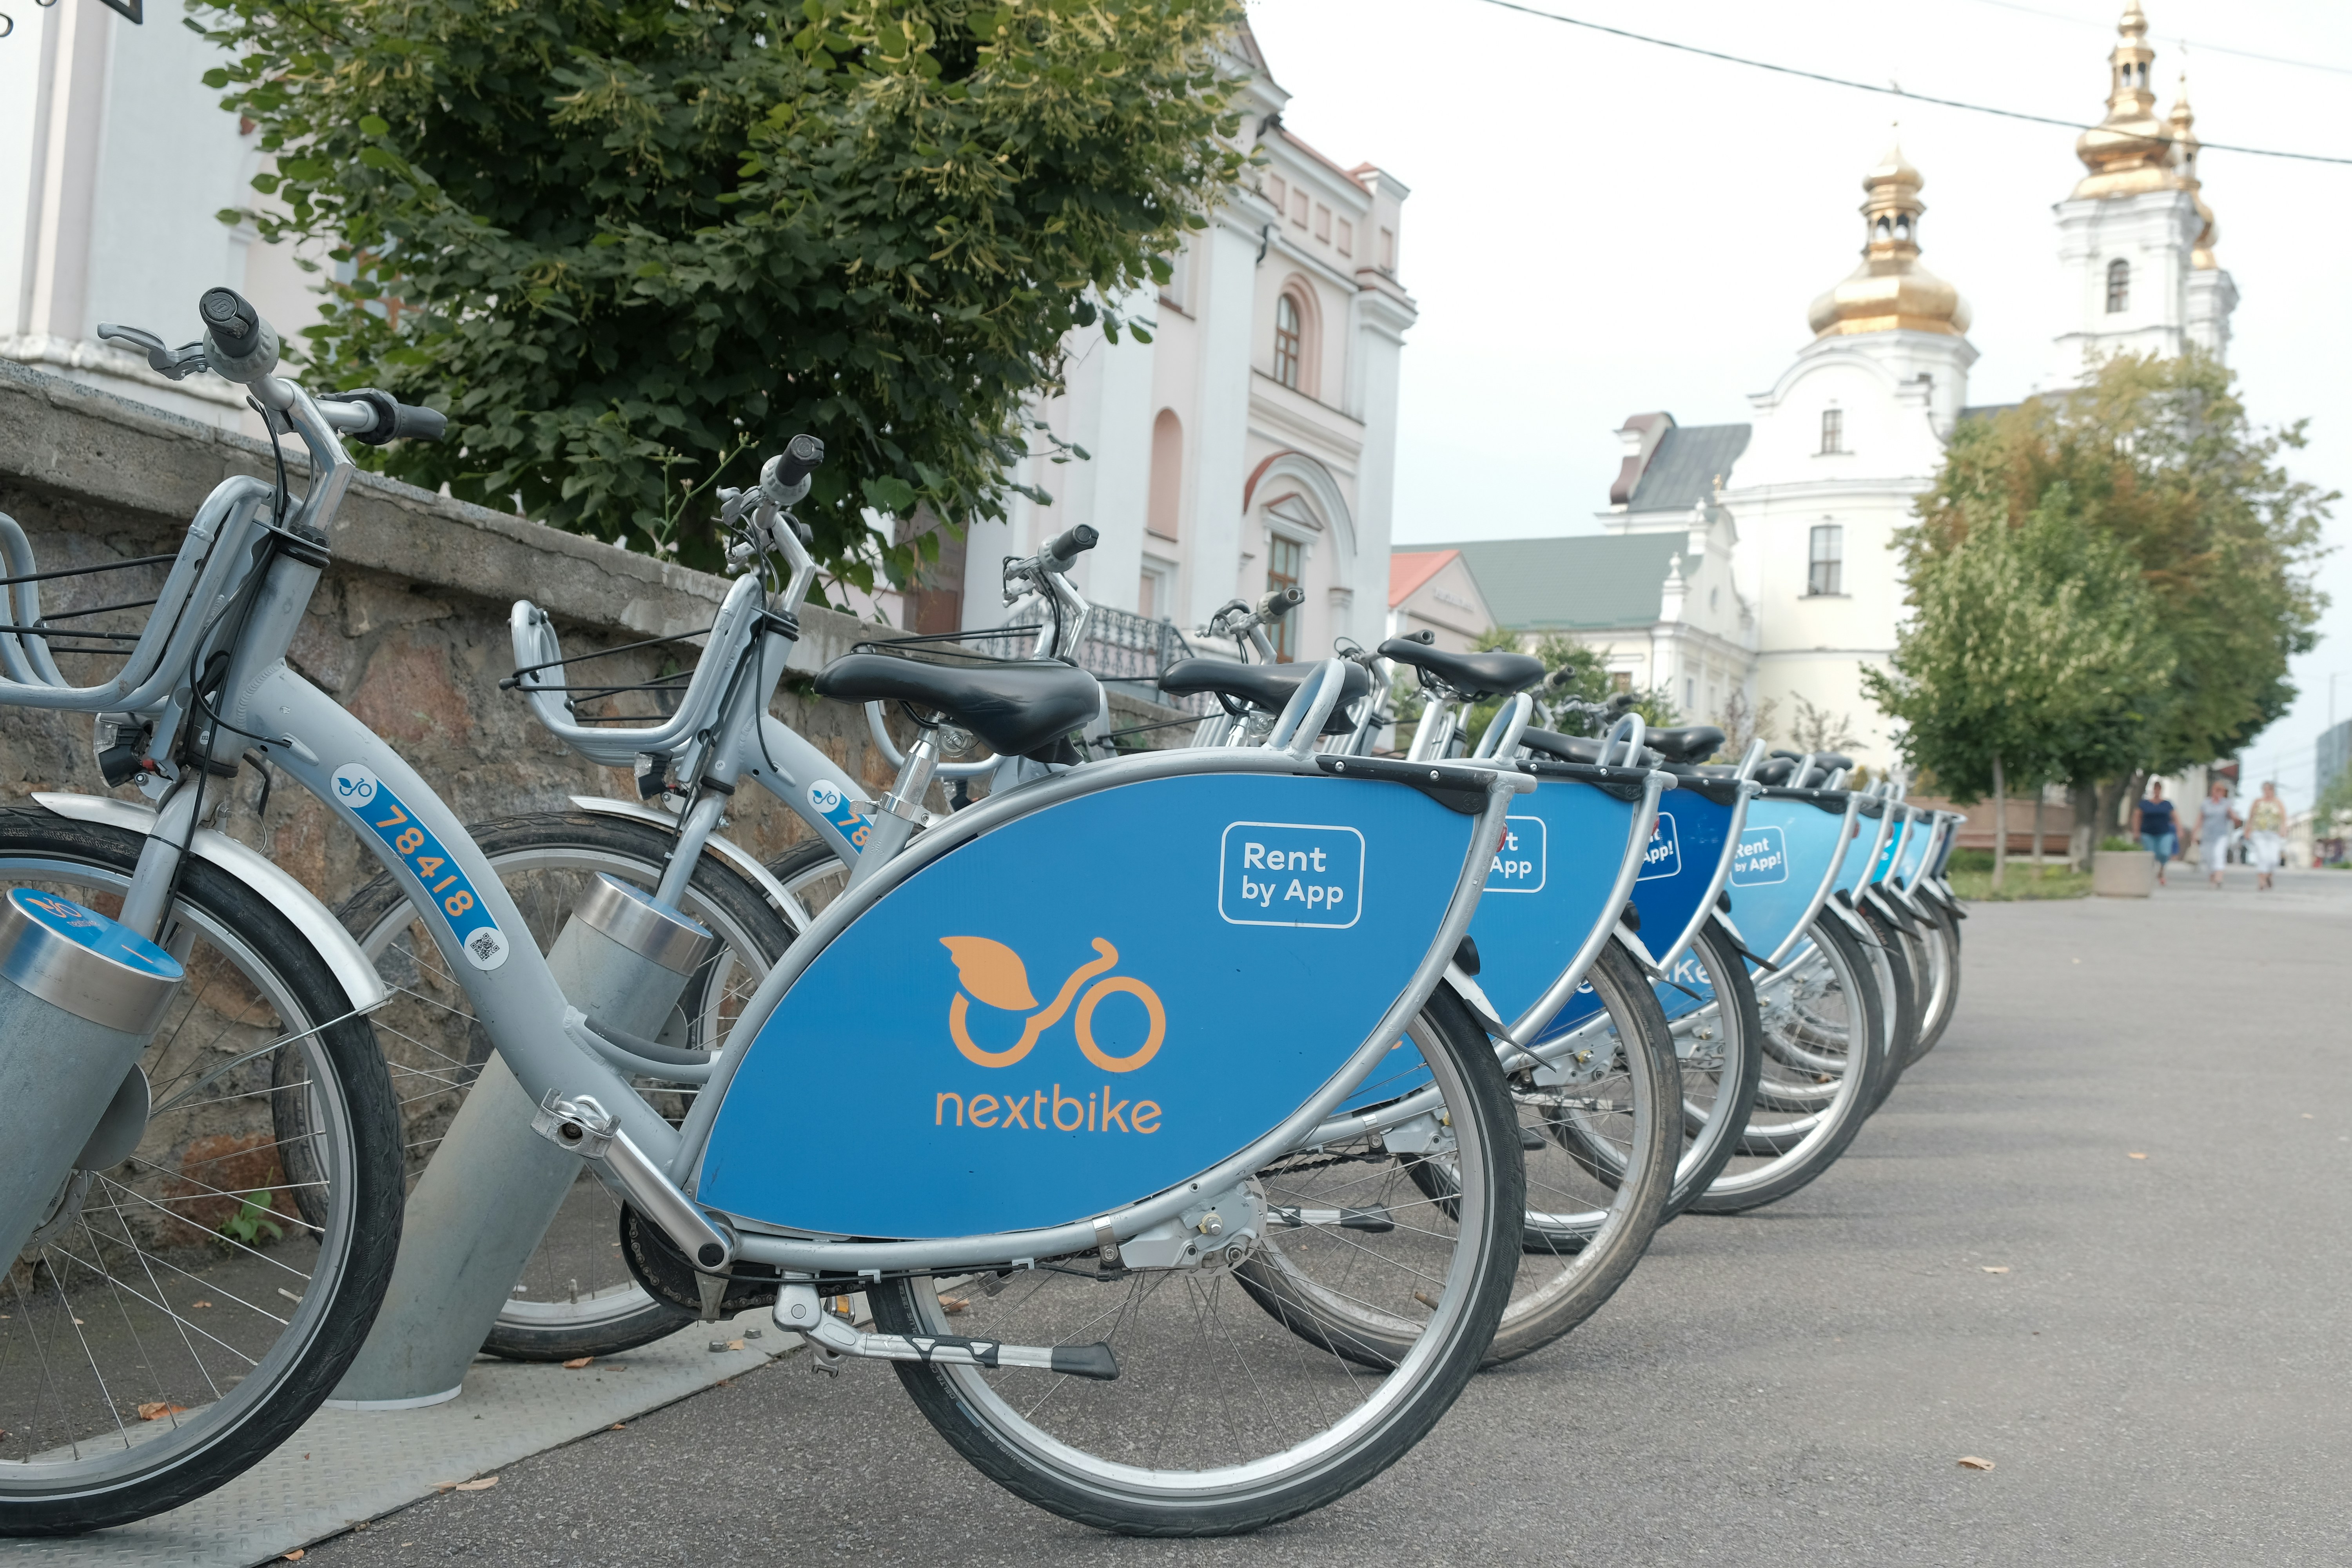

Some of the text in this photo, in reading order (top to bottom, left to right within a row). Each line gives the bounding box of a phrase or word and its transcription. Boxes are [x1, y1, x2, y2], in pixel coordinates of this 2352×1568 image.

[376, 805, 473, 916] 78418
[1244, 842, 1327, 872] Rent
[1735, 837, 1769, 858] Rent
[1490, 856, 1532, 879] App
[1735, 851, 1781, 872] by App!
[1242, 875, 1344, 910] by App
[936, 1083, 1162, 1134] nextbike
[936, 1375, 956, 1399] DELTA
